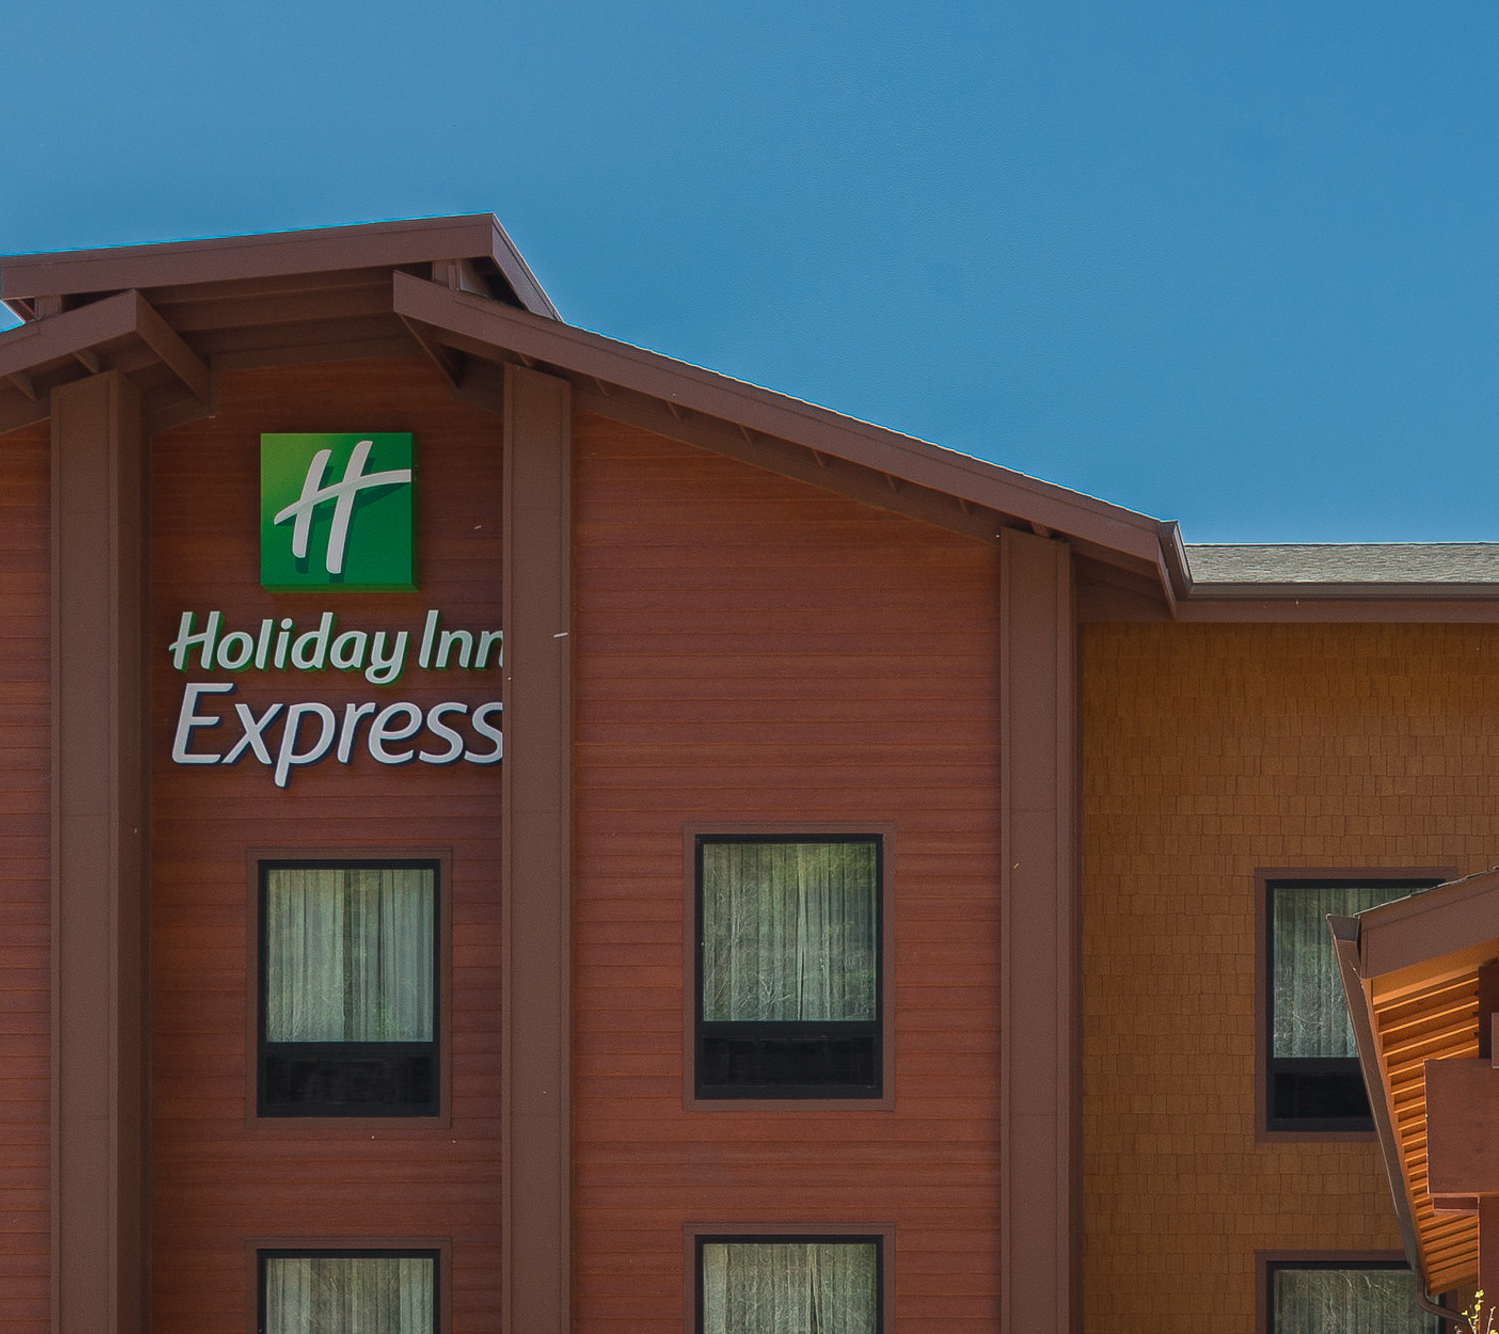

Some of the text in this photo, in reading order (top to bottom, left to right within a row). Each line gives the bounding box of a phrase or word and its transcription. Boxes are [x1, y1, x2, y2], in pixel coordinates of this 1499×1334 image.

[169, 609, 503, 684] Holiday Inn
[172, 682, 503, 788] Express
